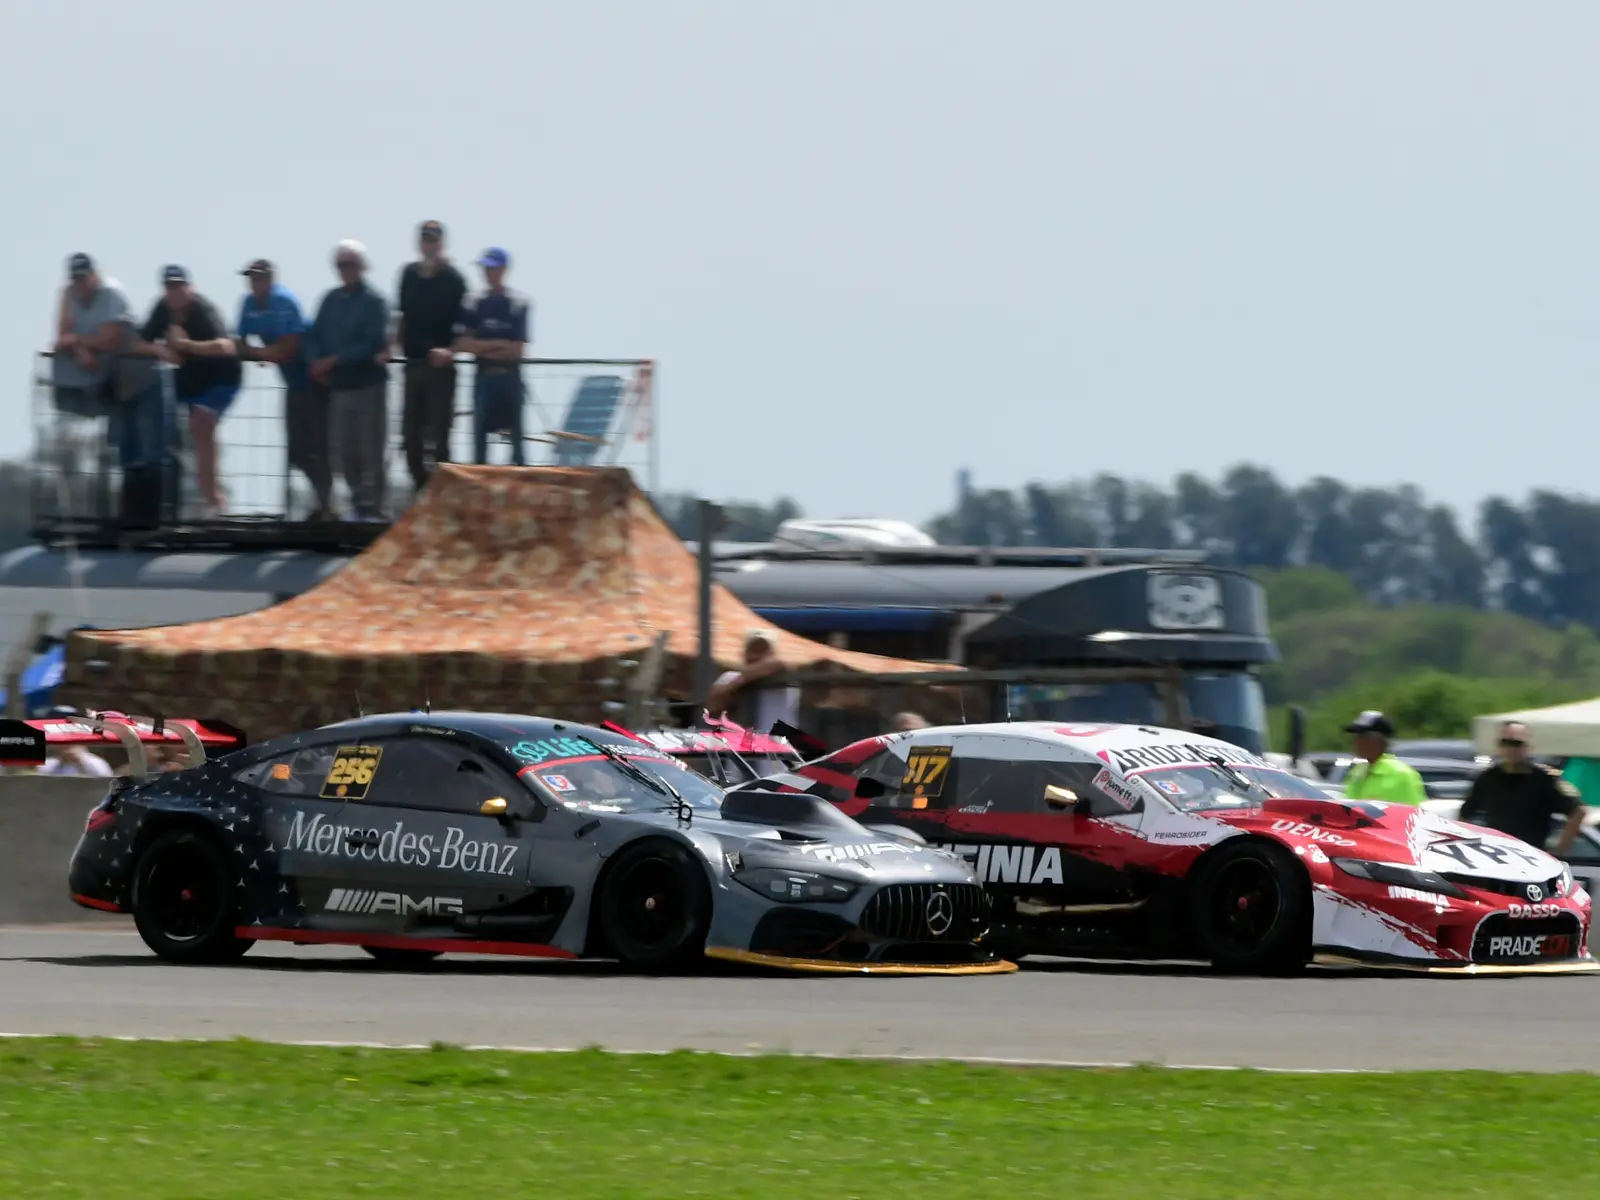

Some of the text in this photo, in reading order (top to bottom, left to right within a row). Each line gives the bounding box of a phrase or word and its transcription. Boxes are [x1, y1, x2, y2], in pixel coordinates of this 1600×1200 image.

[538, 737, 602, 757] Life
[327, 758, 377, 784] 256
[283, 811, 519, 876] Mercedes-Benz
